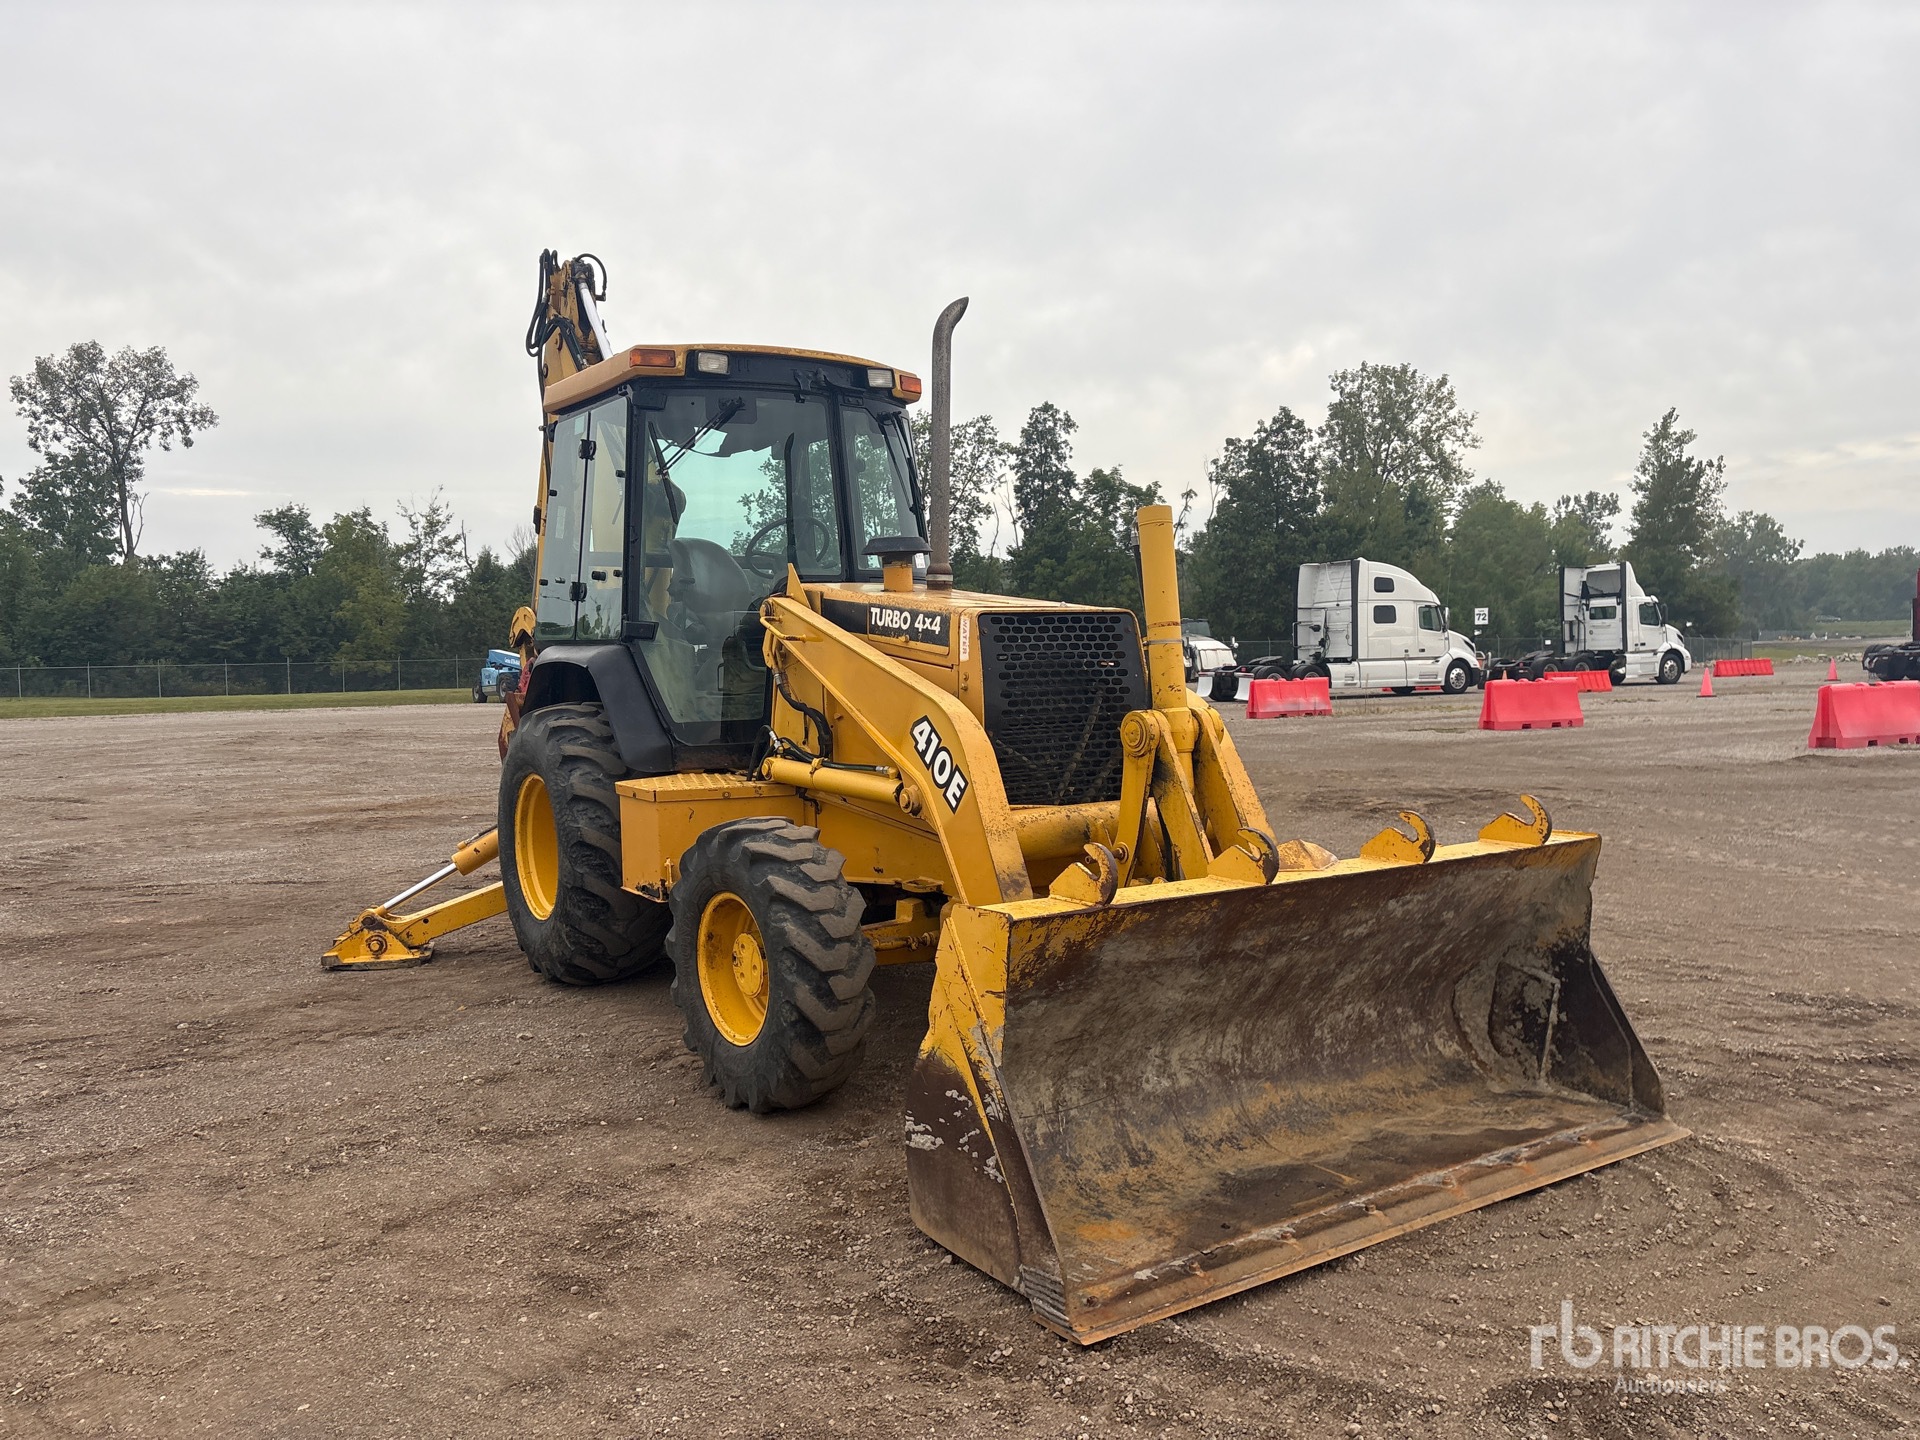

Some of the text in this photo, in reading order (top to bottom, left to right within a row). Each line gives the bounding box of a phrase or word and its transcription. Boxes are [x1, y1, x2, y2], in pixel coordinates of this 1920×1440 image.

[870, 607, 941, 635] TURBO 4x4
[1475, 612, 1487, 621] 72
[912, 719, 966, 809] 410E
